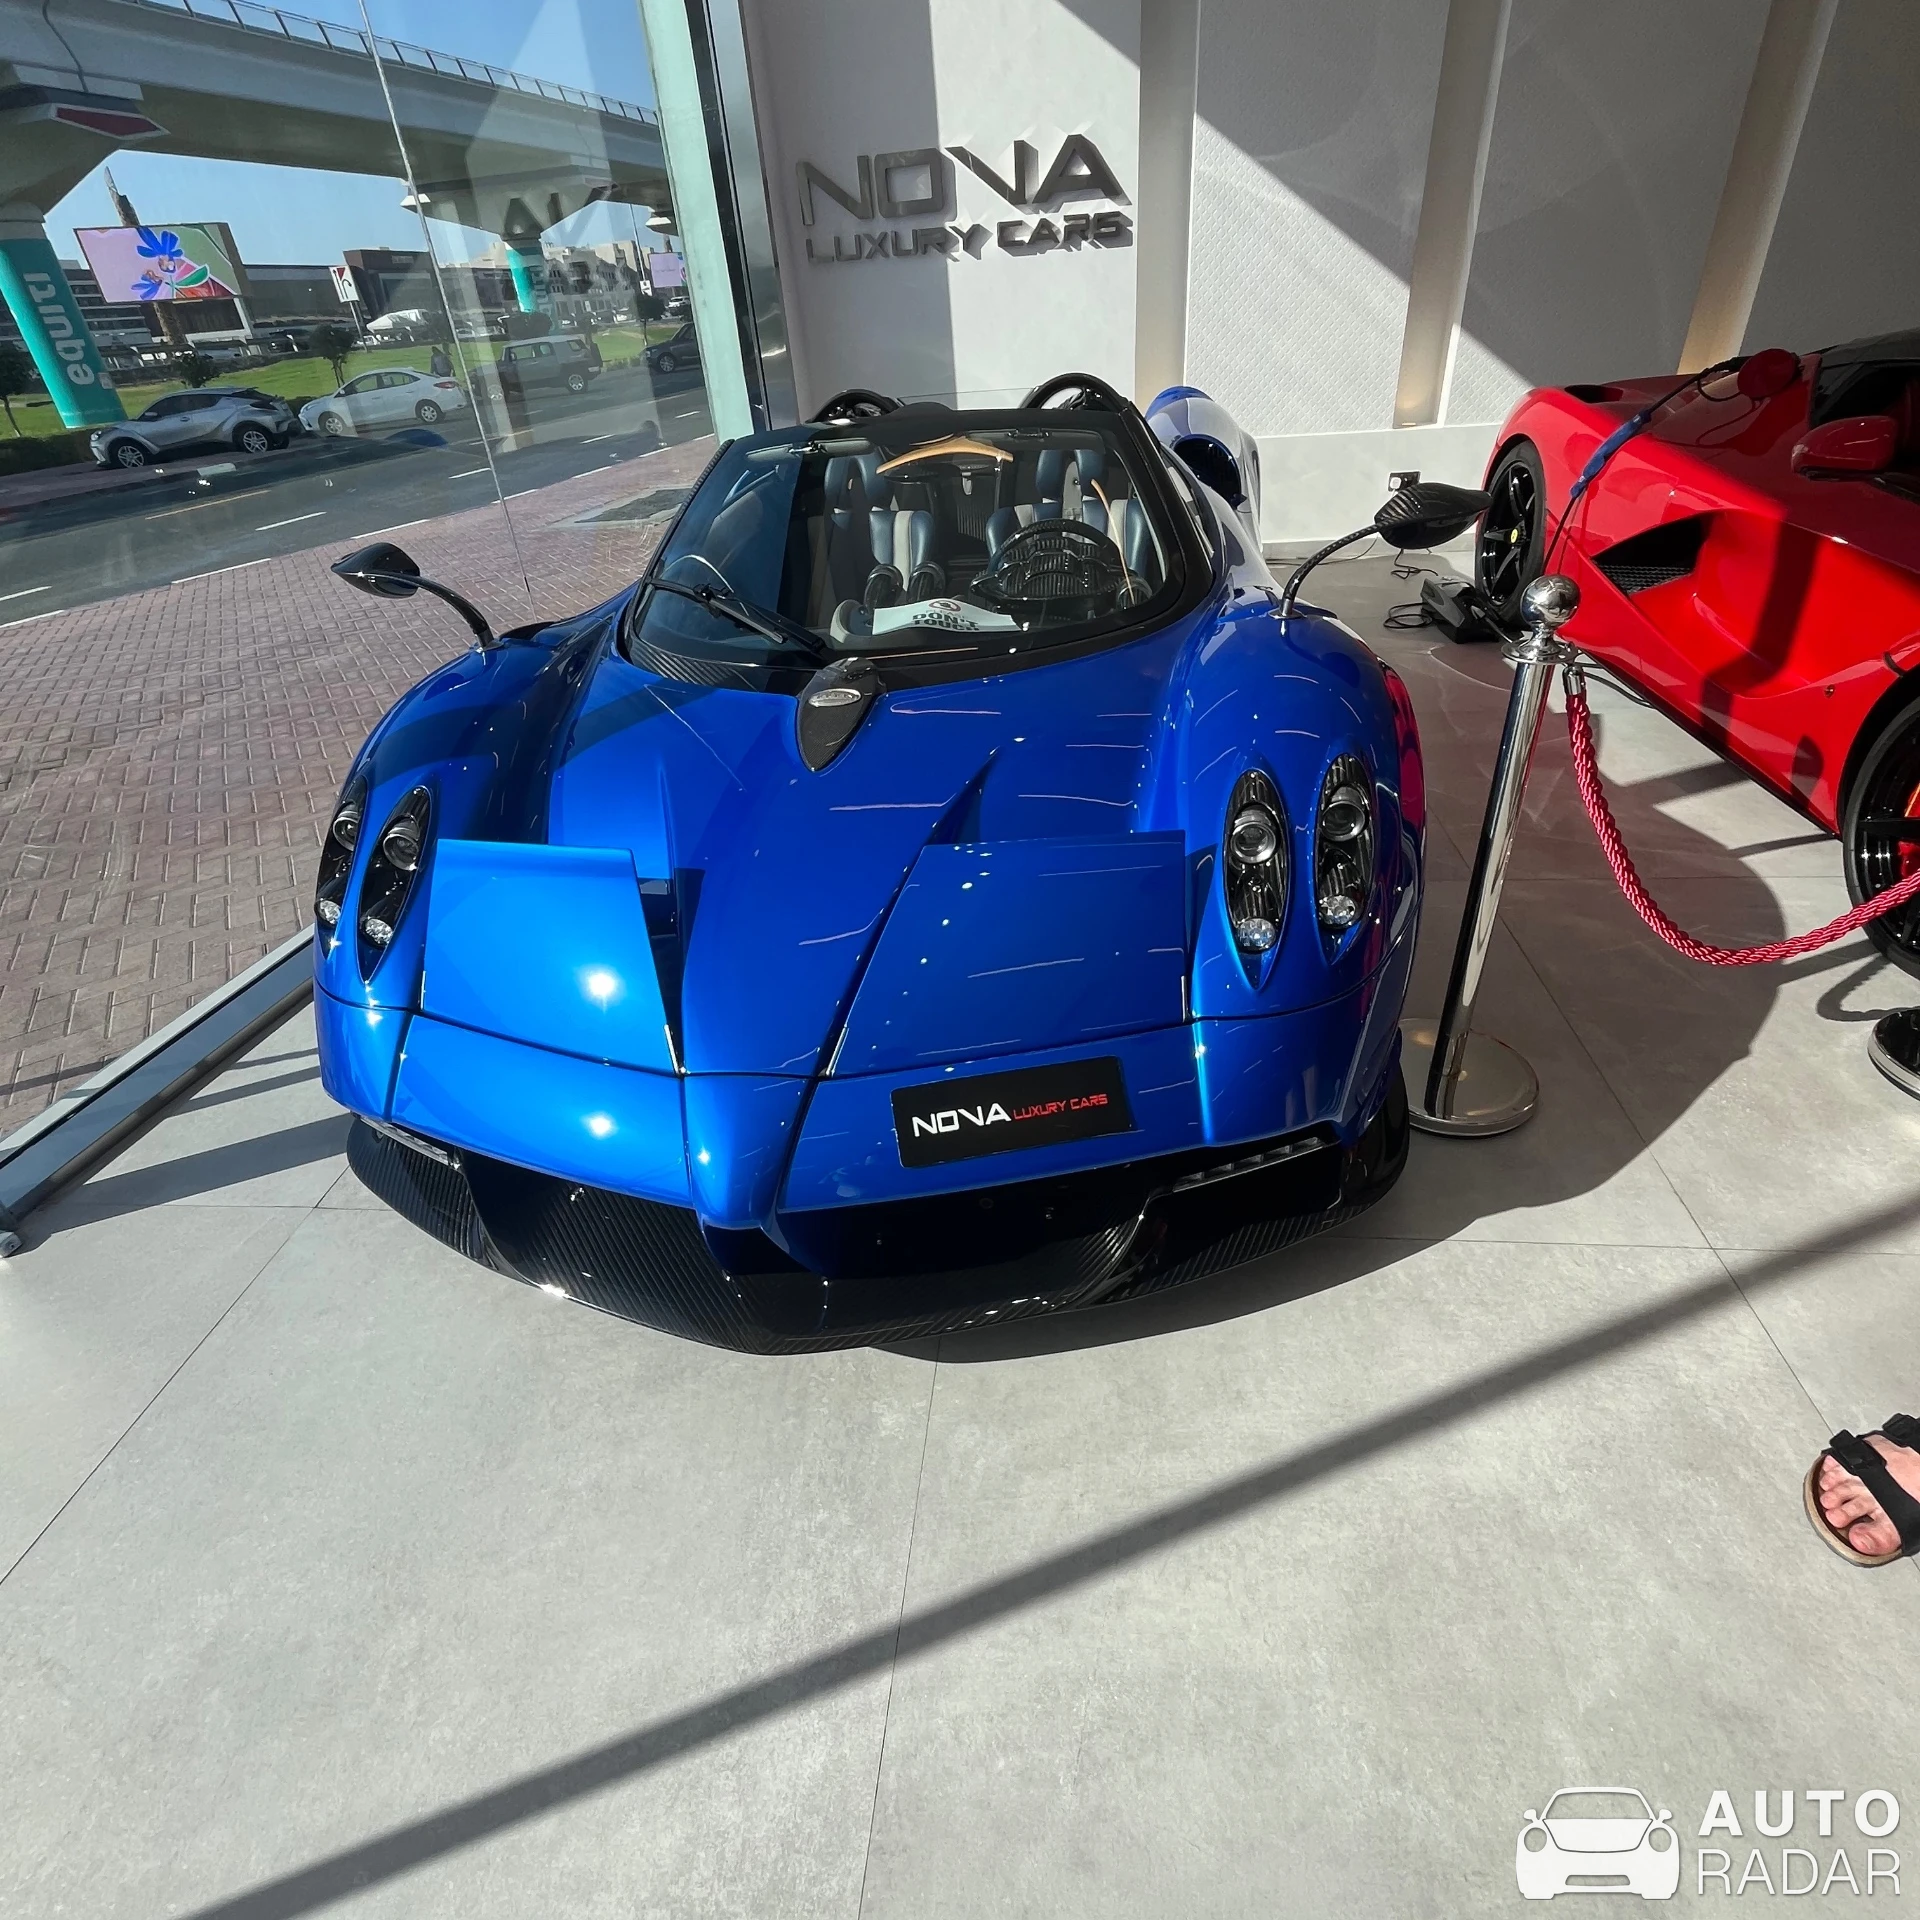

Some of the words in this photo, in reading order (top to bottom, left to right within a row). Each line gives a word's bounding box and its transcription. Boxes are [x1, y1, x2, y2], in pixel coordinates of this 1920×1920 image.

[795, 133, 1132, 226] NOVA
[805, 222, 987, 263] LUXURY
[996, 210, 1131, 251] CARS
[23, 272, 95, 386] equiti
[911, 1102, 1012, 1138] NOVA
[1012, 1099, 1067, 1120] LUXURY
[1070, 1093, 1108, 1110] CARS
